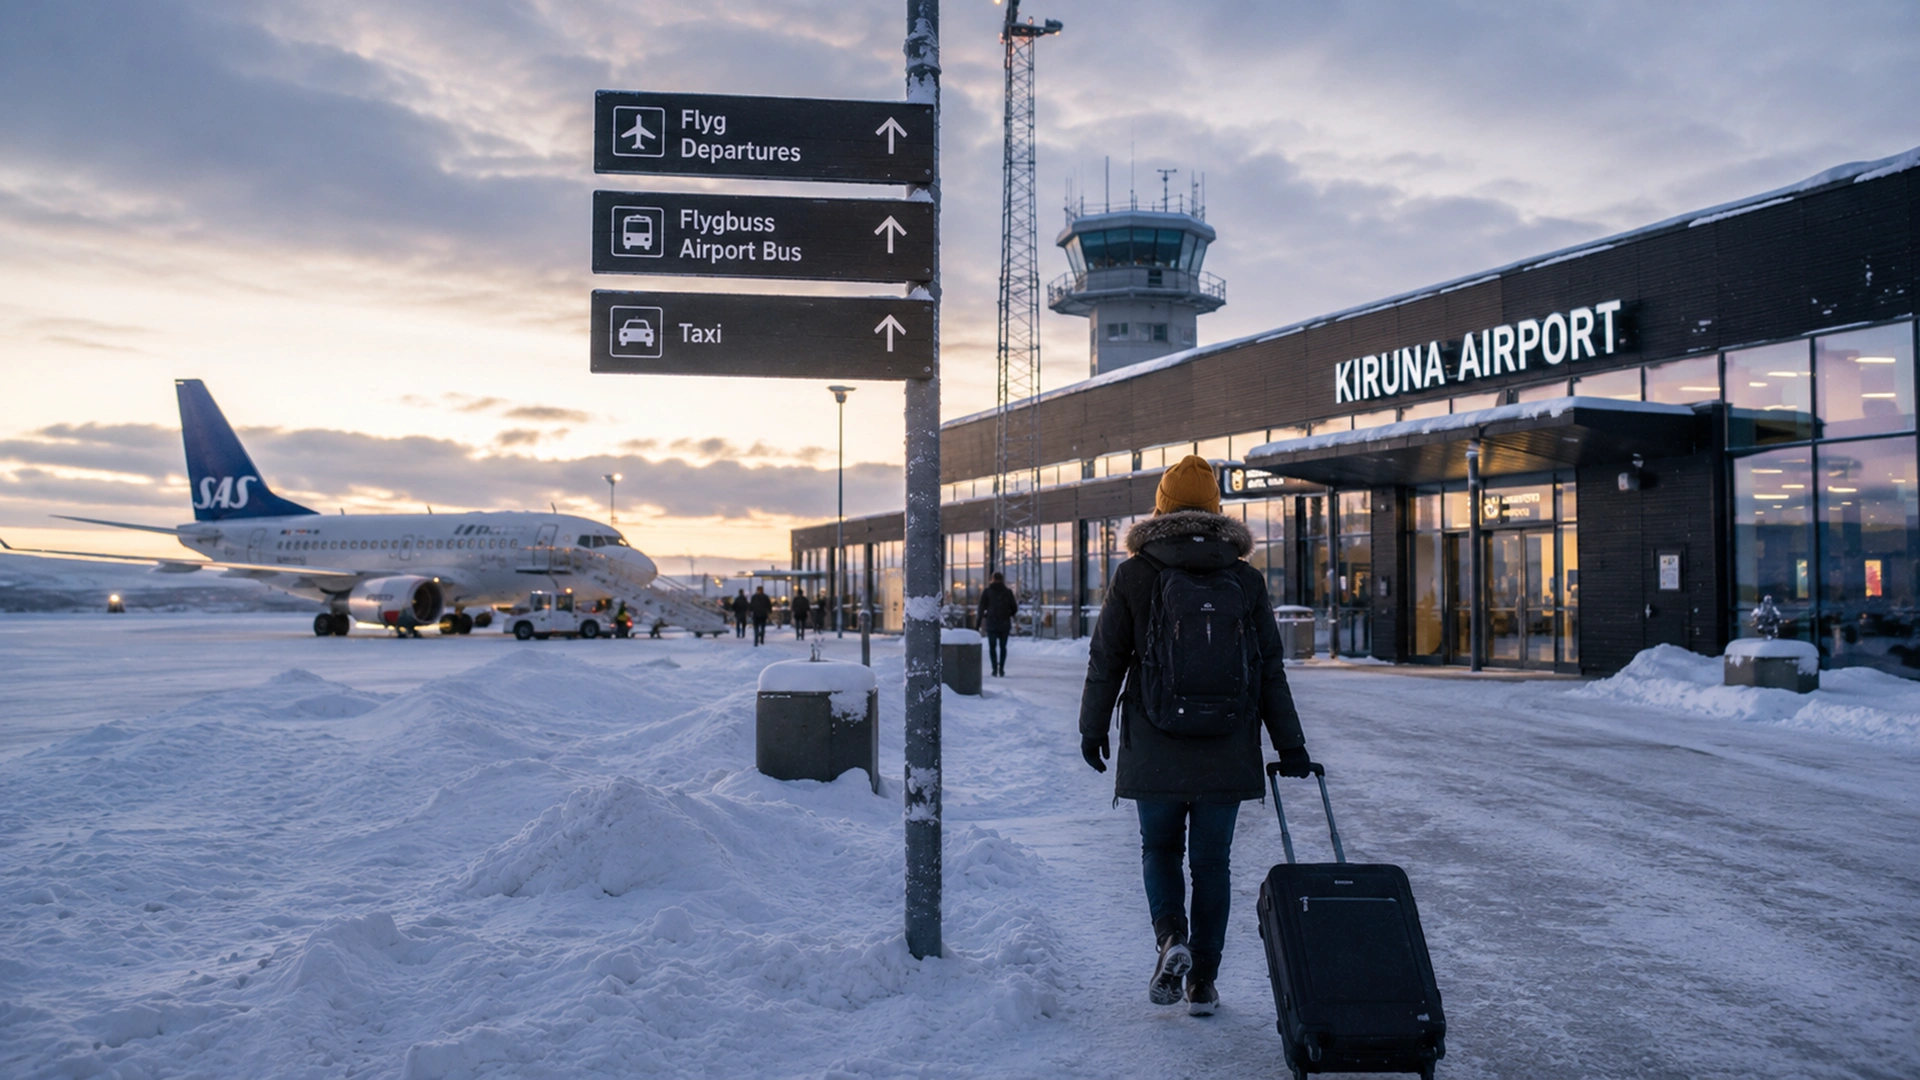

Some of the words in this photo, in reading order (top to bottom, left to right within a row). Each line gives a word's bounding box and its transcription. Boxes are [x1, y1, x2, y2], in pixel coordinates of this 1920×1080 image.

[681, 109, 726, 135] Flyg
[681, 138, 801, 163] Departures
[680, 209, 775, 235] Flygbuss
[680, 239, 756, 263] Airport
[763, 242, 802, 262] Bus
[679, 323, 722, 343] Taxi
[1335, 340, 1446, 404] KIRUNA
[1458, 299, 1621, 382] AIRPORT
[194, 474, 258, 510] SAS
